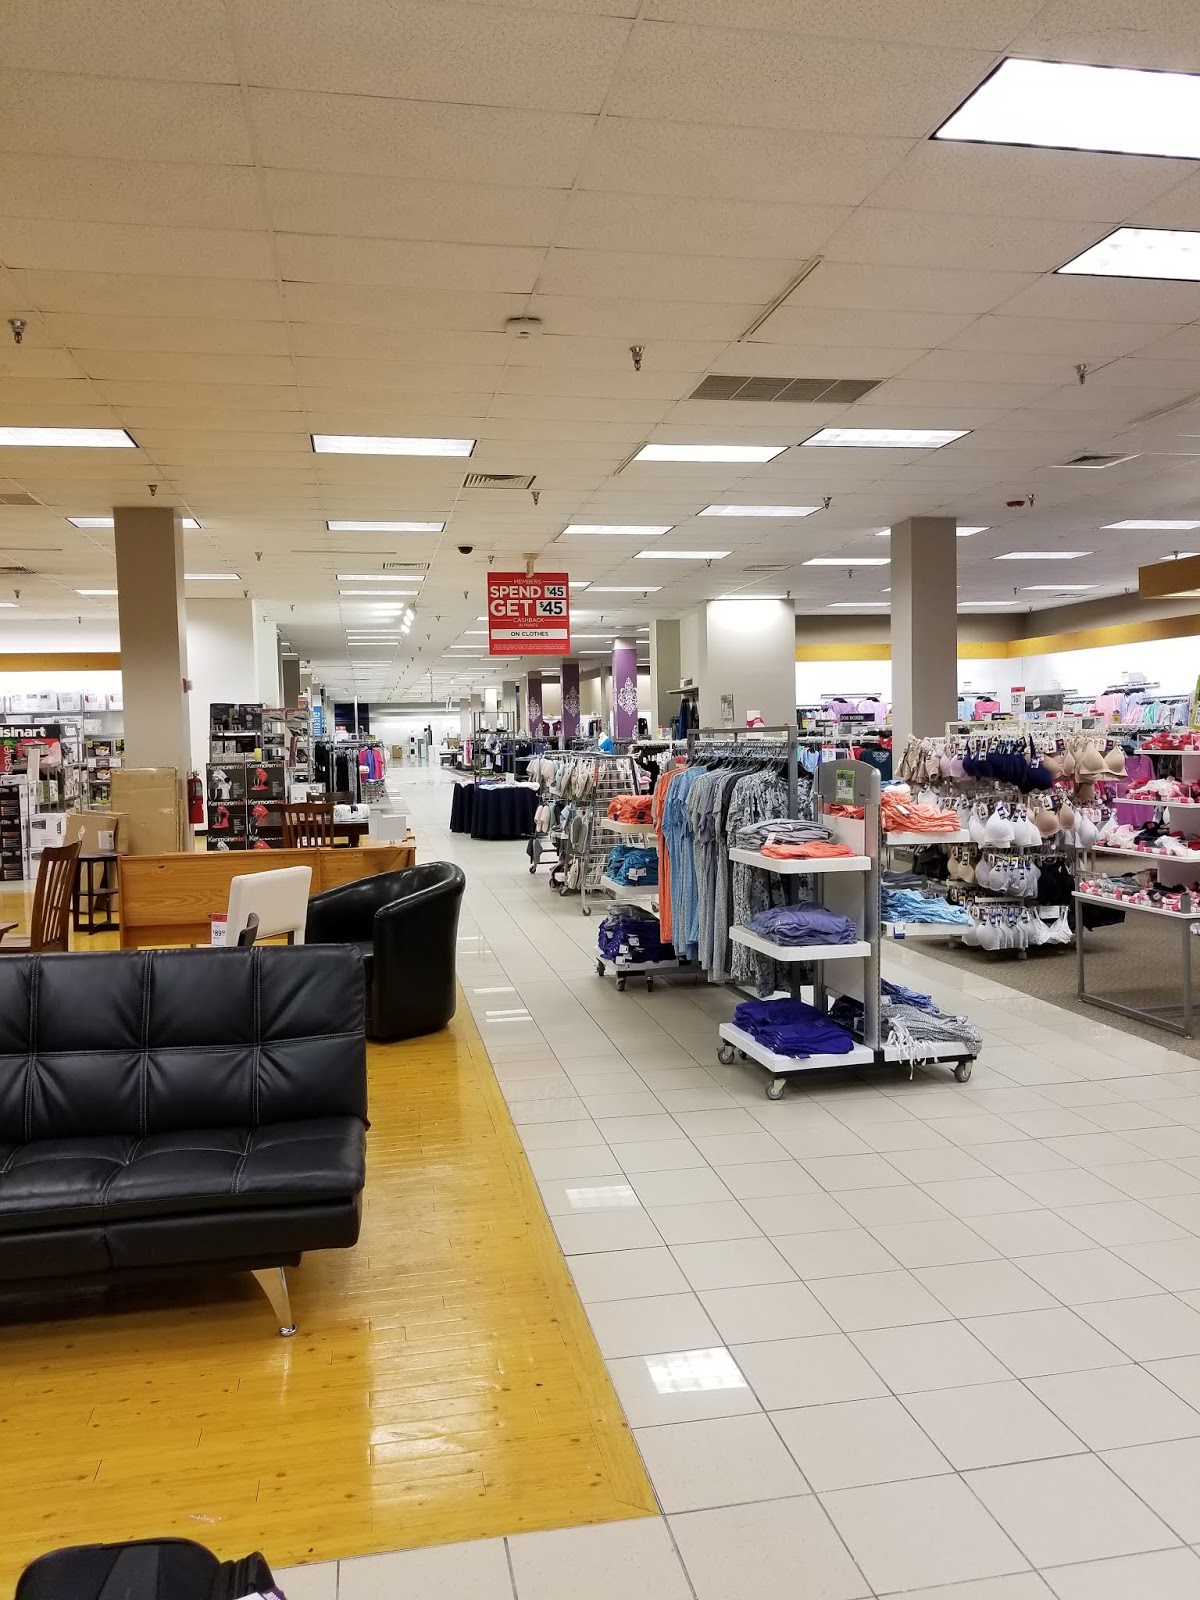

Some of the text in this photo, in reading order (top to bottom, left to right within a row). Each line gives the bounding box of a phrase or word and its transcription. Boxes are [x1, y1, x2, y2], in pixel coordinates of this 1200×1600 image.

[490, 586, 563, 598] SPEND $45
[490, 600, 563, 616] GET $45
[4, 746, 13, 772] save
